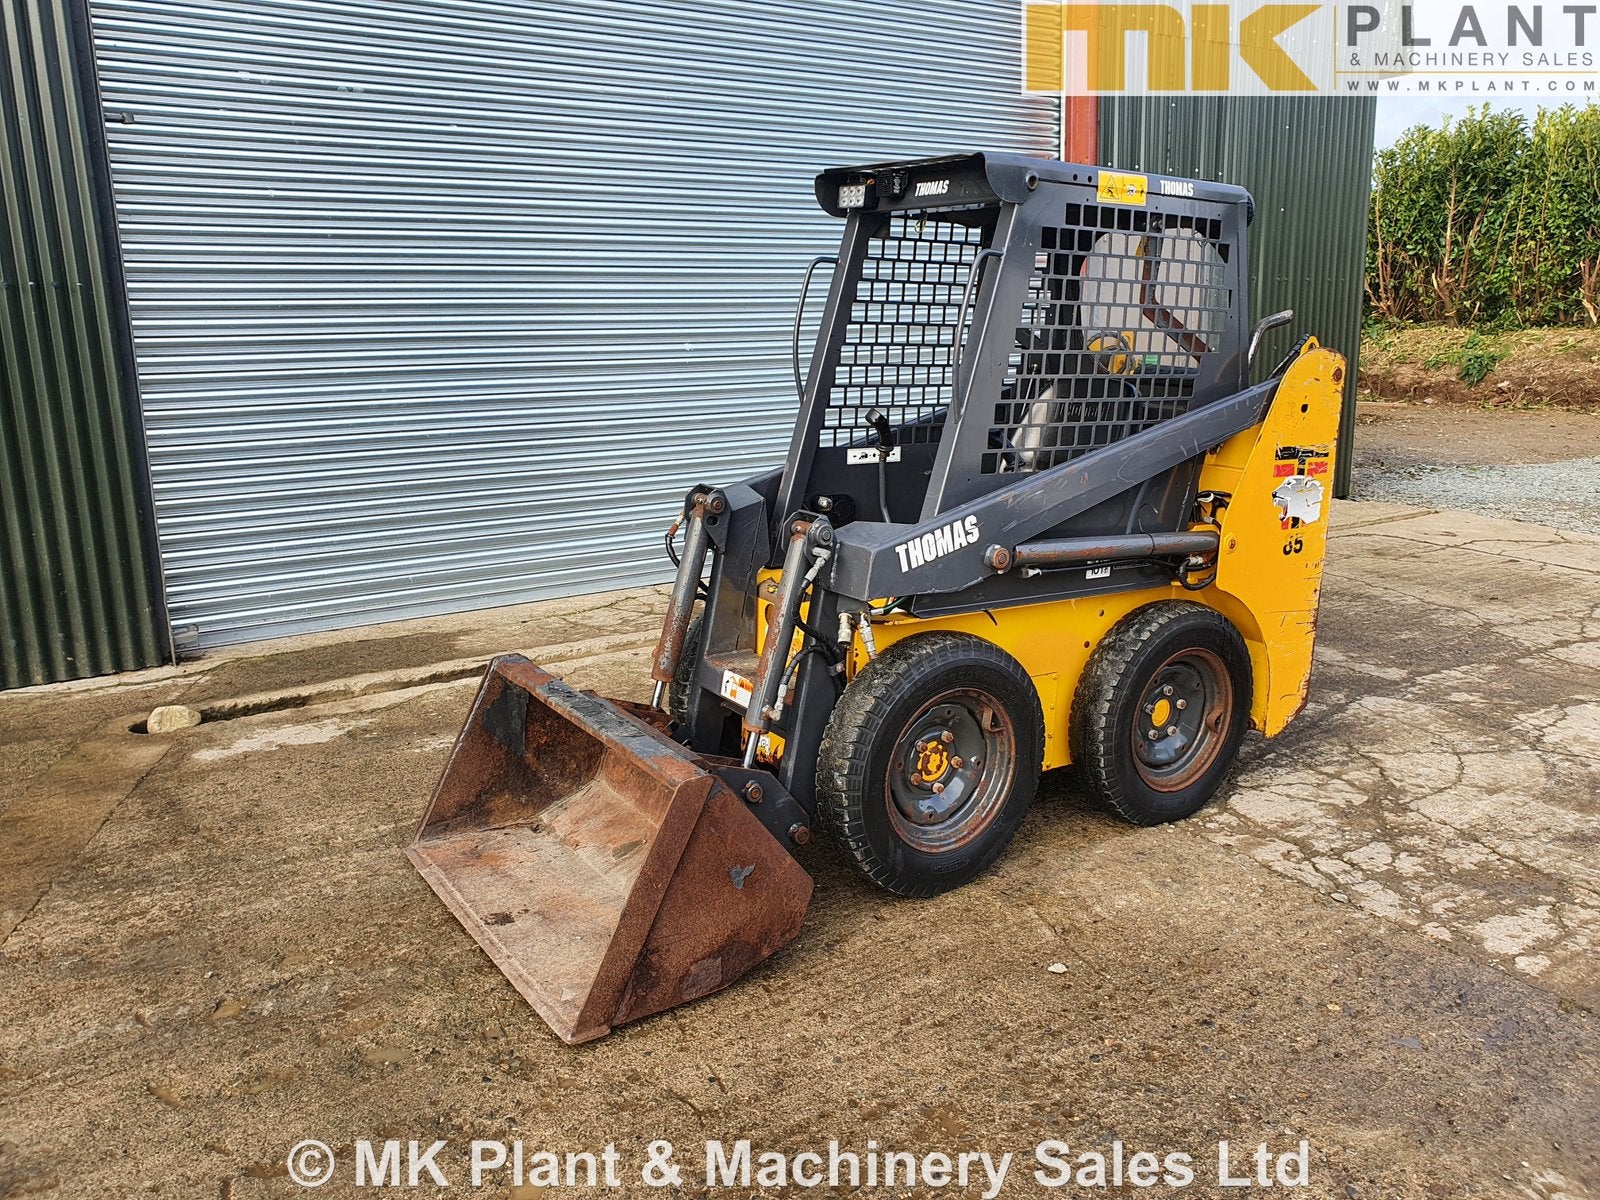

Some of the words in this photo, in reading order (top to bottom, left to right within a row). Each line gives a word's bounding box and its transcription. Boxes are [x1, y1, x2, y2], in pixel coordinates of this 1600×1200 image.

[914, 180, 949, 197] THOMAS
[1159, 180, 1194, 197] THOMAS
[894, 514, 980, 574] THOMAS
